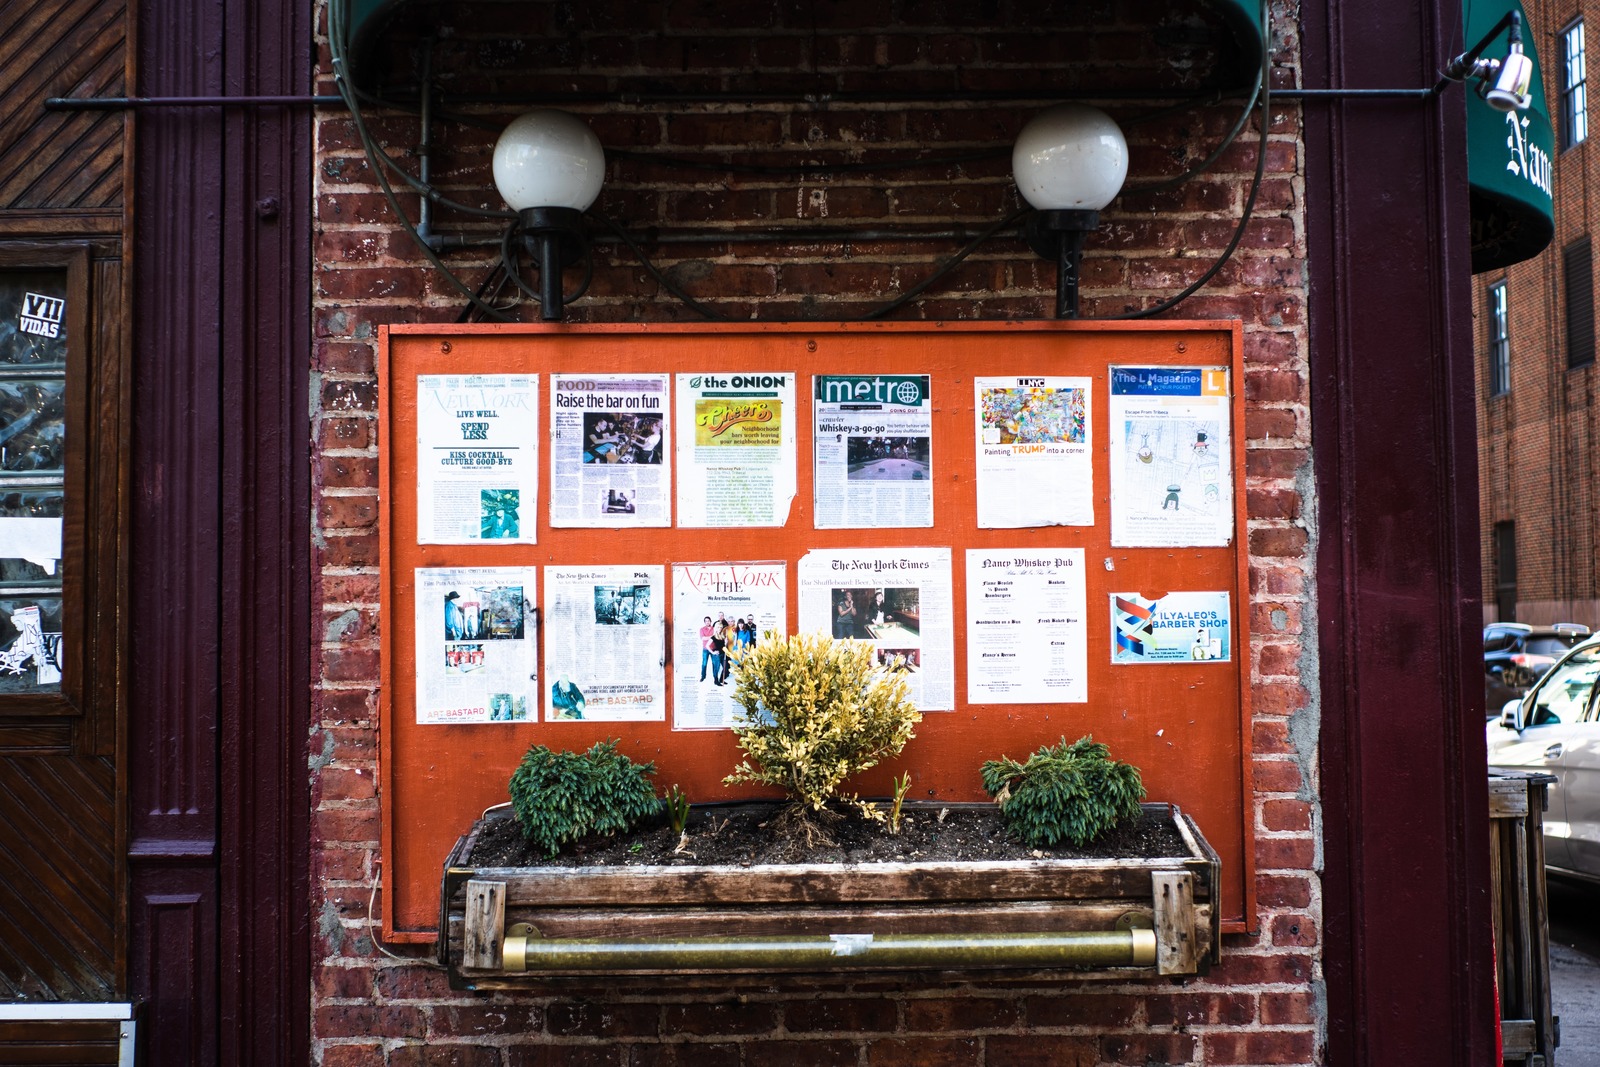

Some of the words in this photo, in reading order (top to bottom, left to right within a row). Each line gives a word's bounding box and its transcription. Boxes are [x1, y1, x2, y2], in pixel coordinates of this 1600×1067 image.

[20, 316, 59, 338] VIDAS
[704, 376, 727, 388] the
[731, 376, 785, 388] ONION
[1017, 379, 1045, 387] LLNYC
[1139, 374, 1145, 382] L
[1208, 372, 1220, 391] L
[556, 380, 596, 390] FOOD
[556, 394, 584, 408] Raise
[587, 394, 604, 408] the
[606, 394, 625, 408] bar
[626, 397, 640, 408] on
[642, 394, 659, 408] fun
[696, 402, 773, 432] Cheers
[819, 424, 885, 434] Whiskey-a-go-go
[1012, 445, 1046, 454] TRUMP
[831, 560, 850, 570] The
[851, 560, 872, 570] New
[874, 560, 898, 572] York
[900, 559, 930, 569] Times
[982, 558, 1010, 568] Nancy
[1014, 558, 1051, 568] Whiskey
[1054, 558, 1073, 568] Pub
[676, 567, 726, 592] NEW
[730, 567, 782, 590] YORK
[714, 582, 744, 592] THE
[1160, 611, 1217, 620] ILYA-LEO'S
[1200, 620, 1228, 628] SHOP
[586, 698, 604, 706] ART
[607, 695, 653, 705] BASTARD
[427, 710, 444, 718] ART
[446, 708, 485, 717] BASTARD
